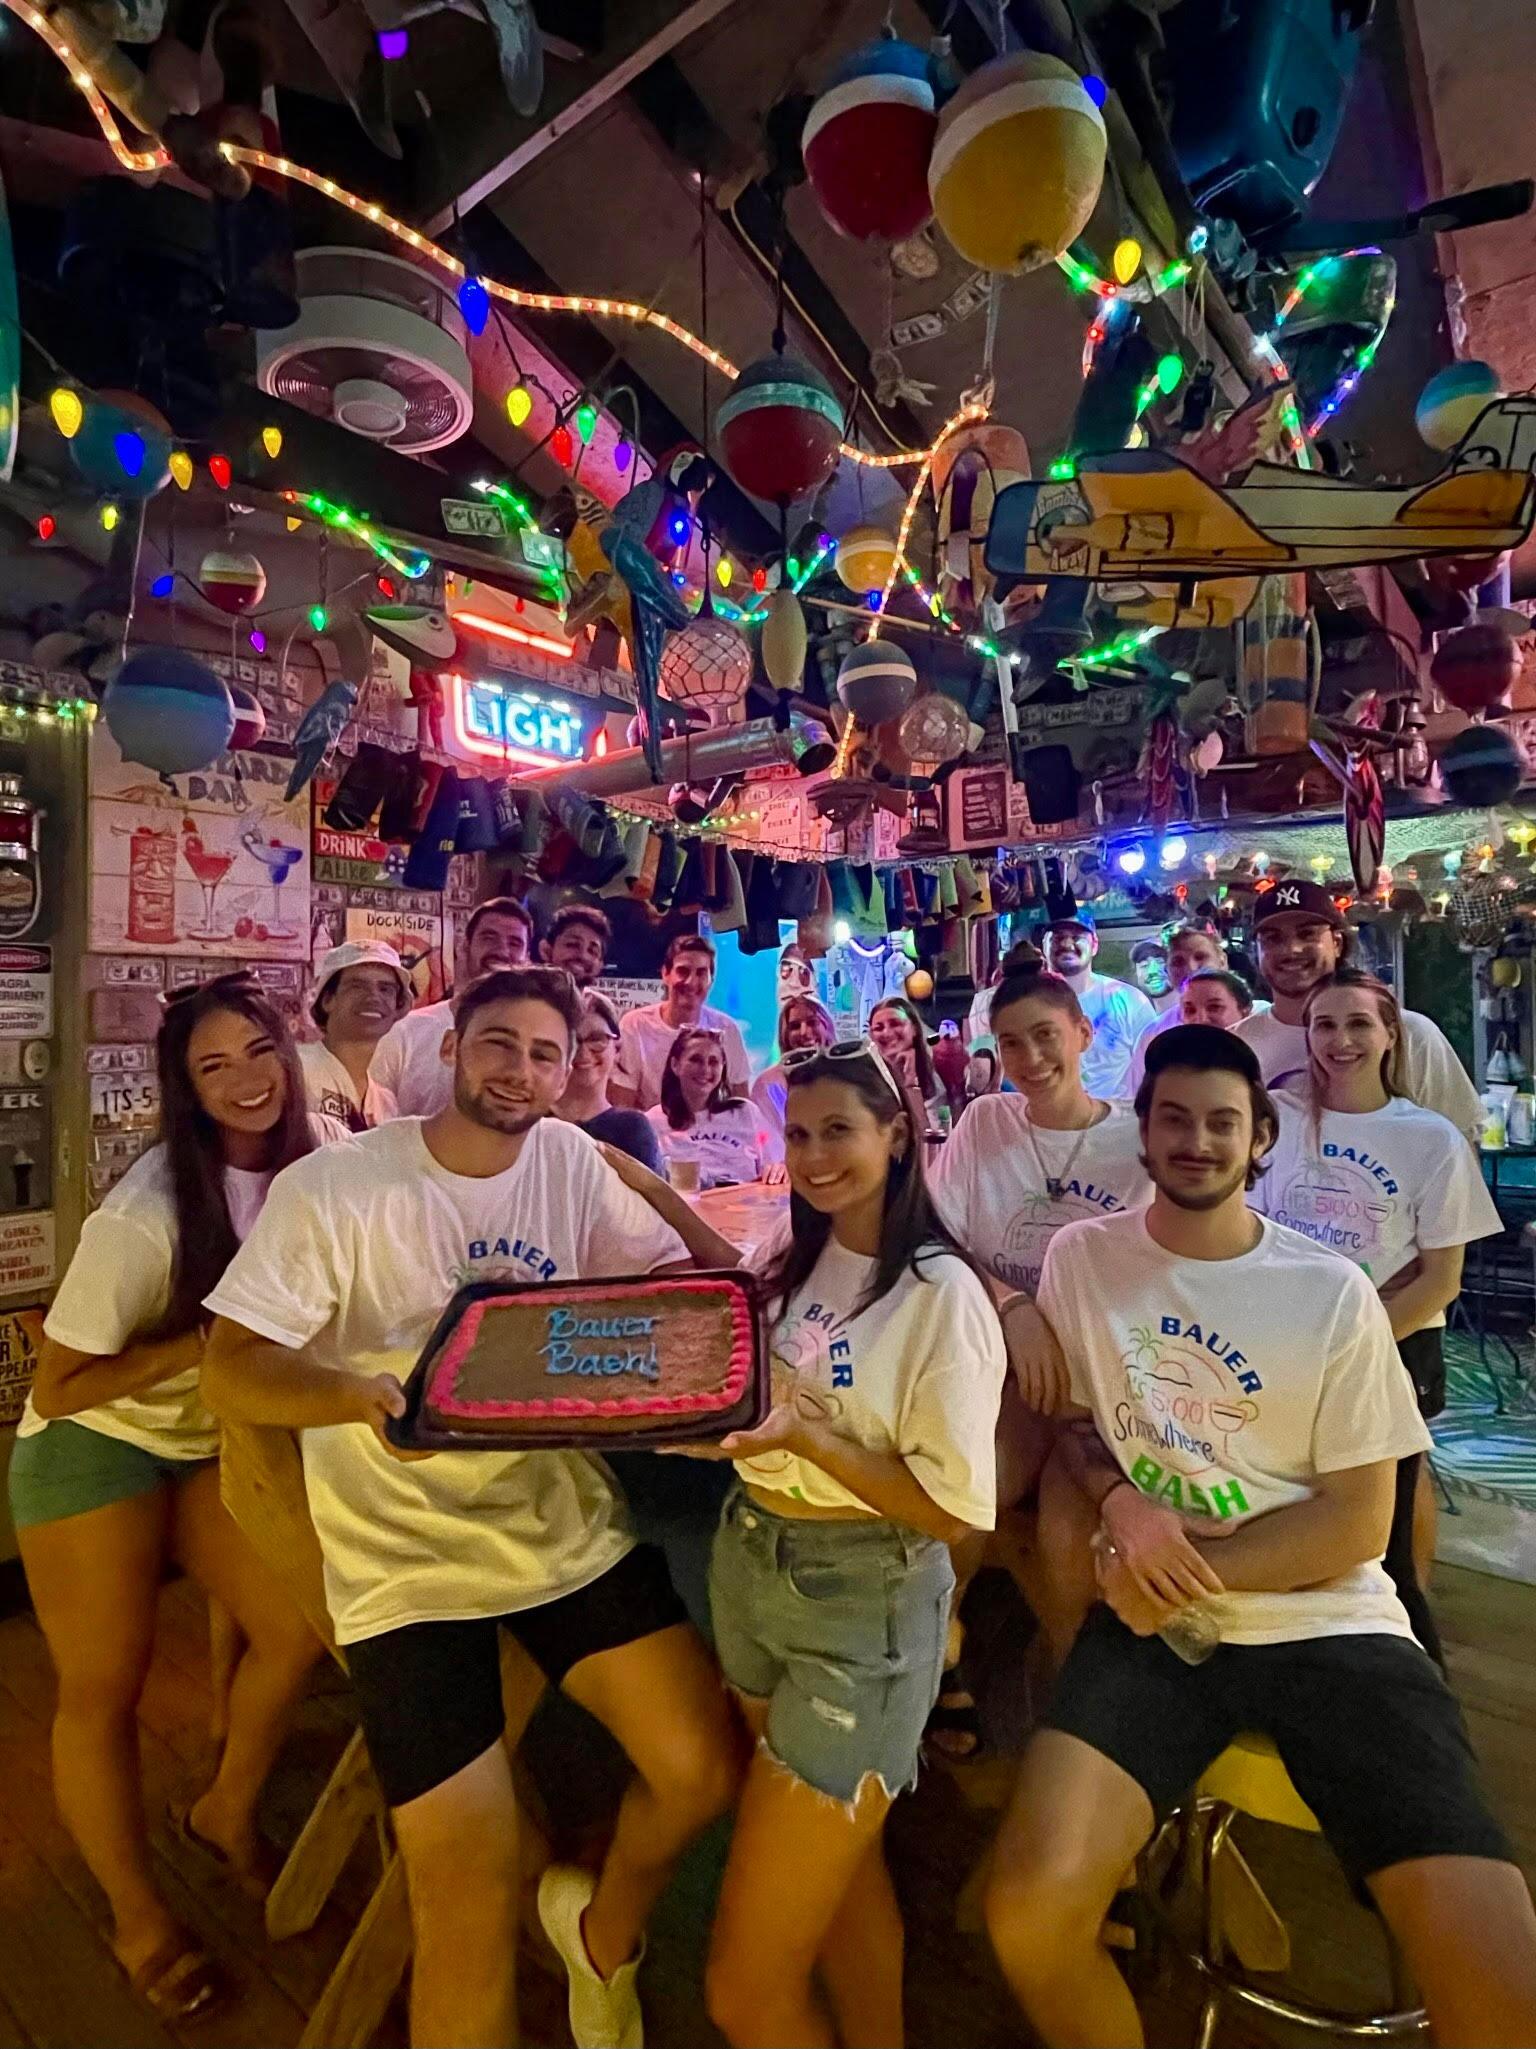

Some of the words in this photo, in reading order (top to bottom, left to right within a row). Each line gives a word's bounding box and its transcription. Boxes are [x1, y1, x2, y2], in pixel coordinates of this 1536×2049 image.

[188, 776, 252, 806] BAR
[1323, 1143, 1399, 1196] BAUER
[1046, 1177, 1127, 1213] BAUE
[468, 1237, 558, 1280] BAUER
[543, 1307, 660, 1340] Bauer
[538, 1340, 660, 1381] Bash!
[803, 1303, 854, 1390] BAUER
[1160, 1316, 1264, 1395] BAUER
[1130, 1453, 1250, 1520] BASH
